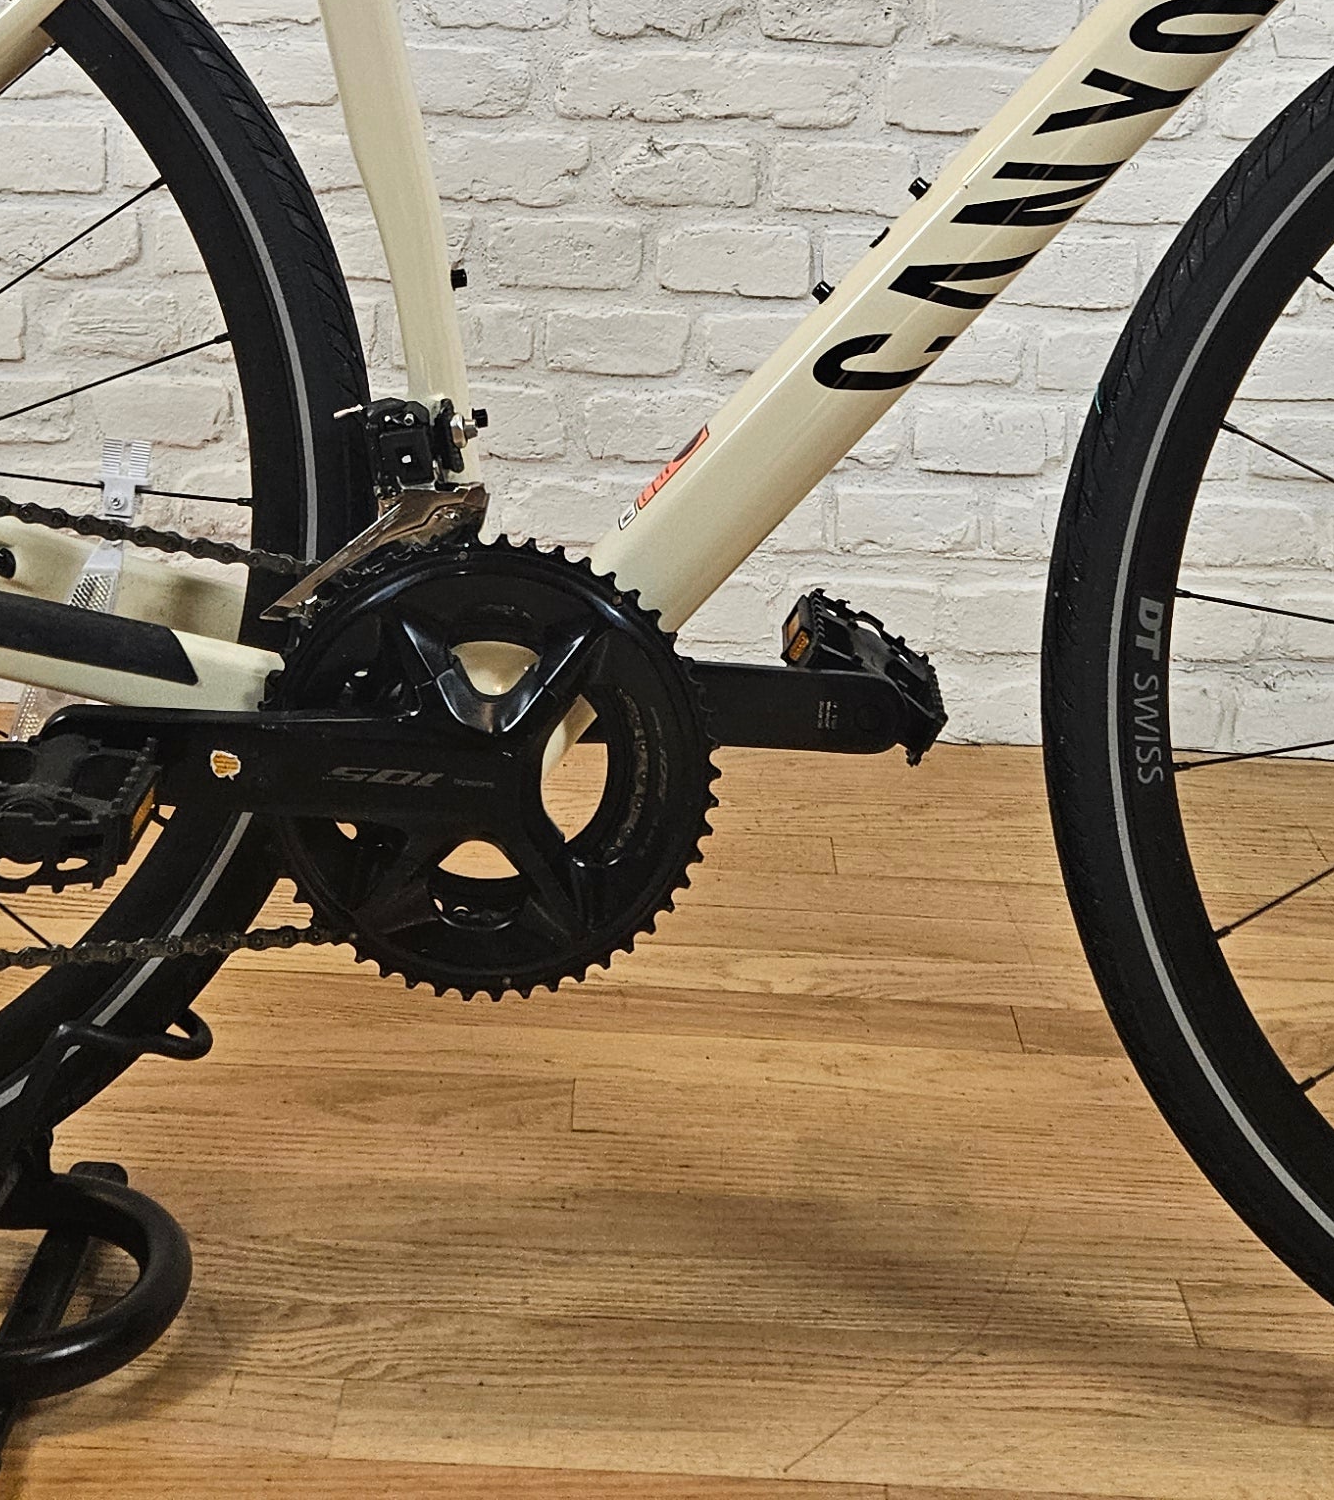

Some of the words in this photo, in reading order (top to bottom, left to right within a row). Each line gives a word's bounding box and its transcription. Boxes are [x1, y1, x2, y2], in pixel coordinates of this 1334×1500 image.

[1134, 596, 1165, 662] DT
[1133, 671, 1165, 785] SWISS
[322, 765, 445, 789] 105
